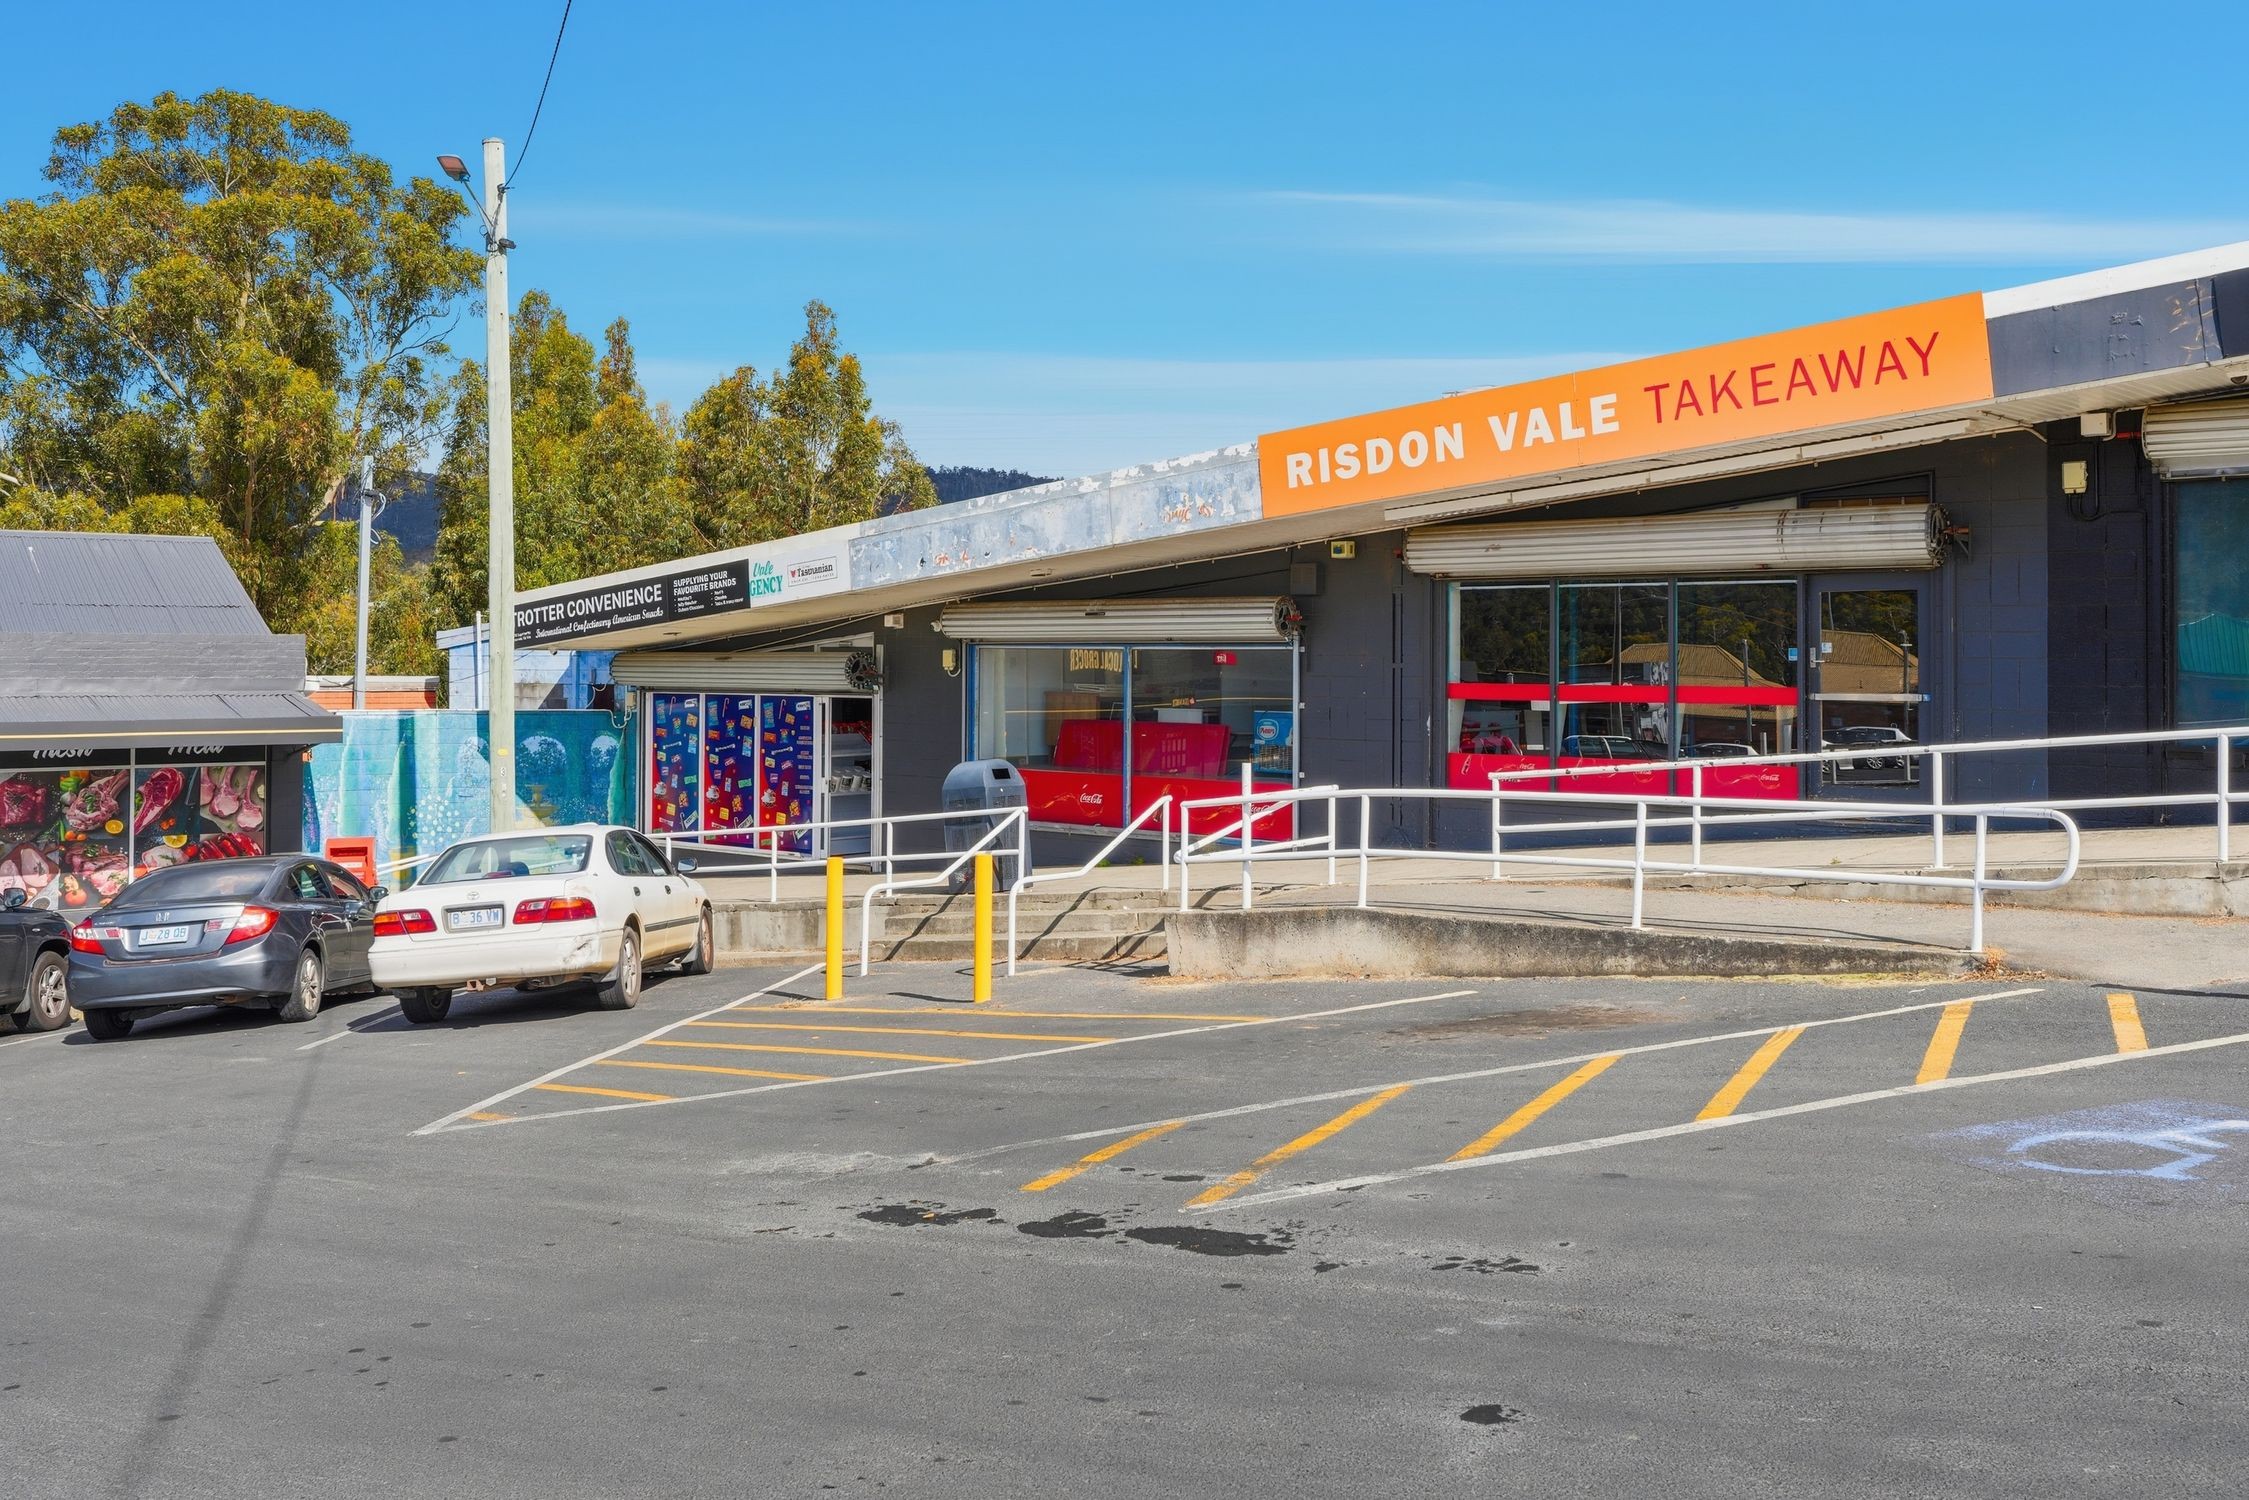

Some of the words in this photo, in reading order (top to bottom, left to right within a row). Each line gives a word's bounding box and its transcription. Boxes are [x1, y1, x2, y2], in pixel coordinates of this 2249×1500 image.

[1287, 422, 1465, 489] RISDON
[1487, 392, 1620, 452] VALE
[1643, 330, 1941, 424] TAKEAWAY
[673, 574, 709, 588] SUPPLYING
[709, 570, 728, 581] YOUR
[797, 563, 833, 578] Tasmanian
[673, 583, 709, 596] FAVOURITE
[709, 577, 737, 591] BRANDS
[566, 583, 663, 618] CONVENIENCE
[612, 613, 641, 625] American
[642, 606, 664, 620] Snacks
[1080, 792, 1103, 804] Coca-Cola
[470, 911, 482, 923] 36
[157, 929, 170, 939] 28
